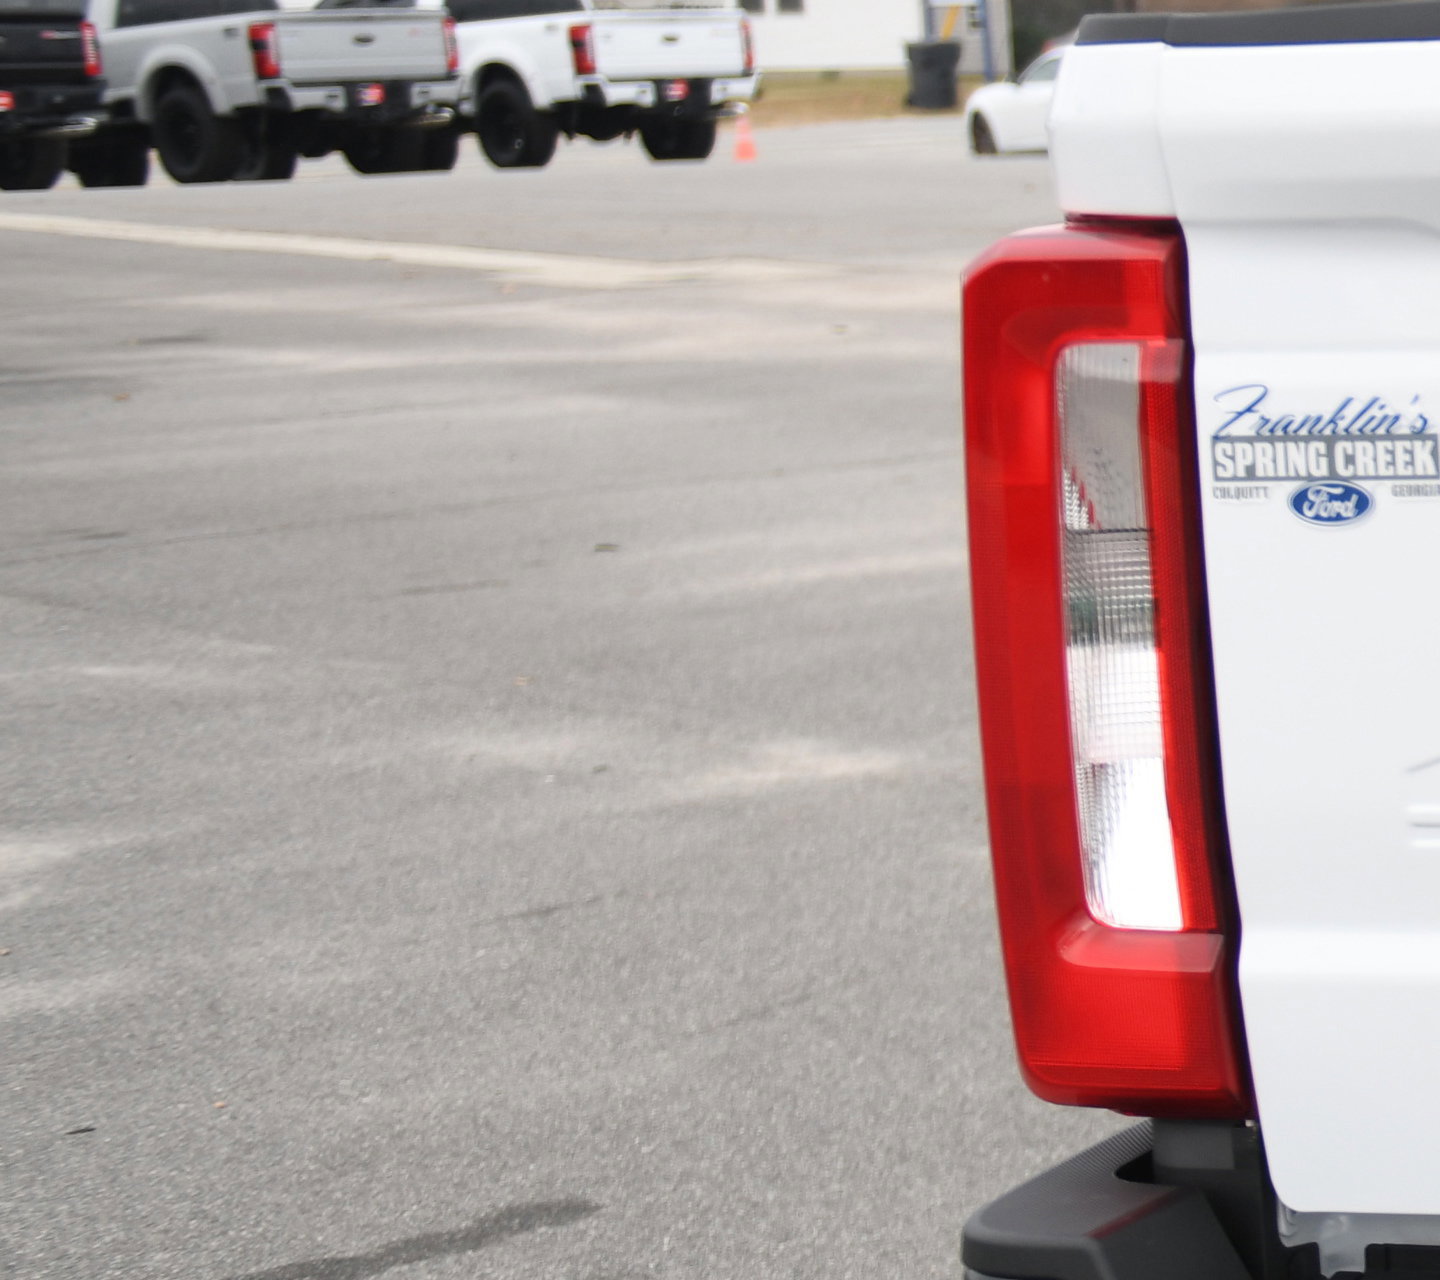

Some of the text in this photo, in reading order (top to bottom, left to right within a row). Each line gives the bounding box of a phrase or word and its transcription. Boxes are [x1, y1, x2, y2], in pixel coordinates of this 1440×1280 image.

[1213, 384, 1430, 440] Franklin's
[1214, 439, 1437, 478] SPRING CREEK
[1212, 485, 1270, 500] COLQUITT
[1302, 485, 1359, 518] Ford
